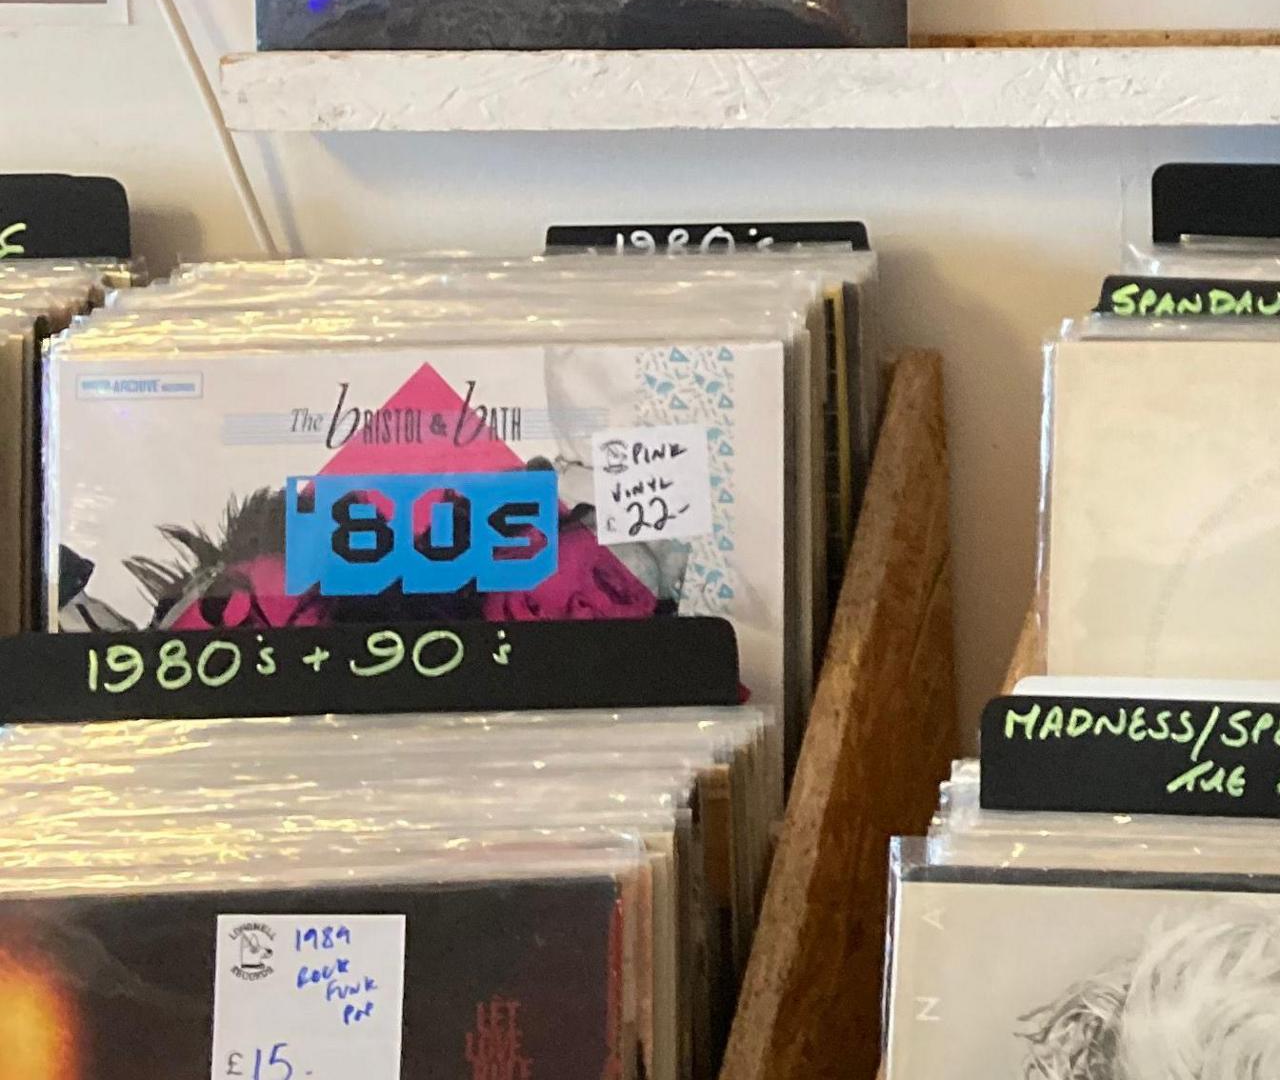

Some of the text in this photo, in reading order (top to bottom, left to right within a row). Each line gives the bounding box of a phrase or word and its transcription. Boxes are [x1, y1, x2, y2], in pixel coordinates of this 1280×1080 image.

[290, 407, 323, 433] The
[429, 413, 448, 437] &
[302, 646, 331, 672] +
[295, 925, 351, 952] 1989
